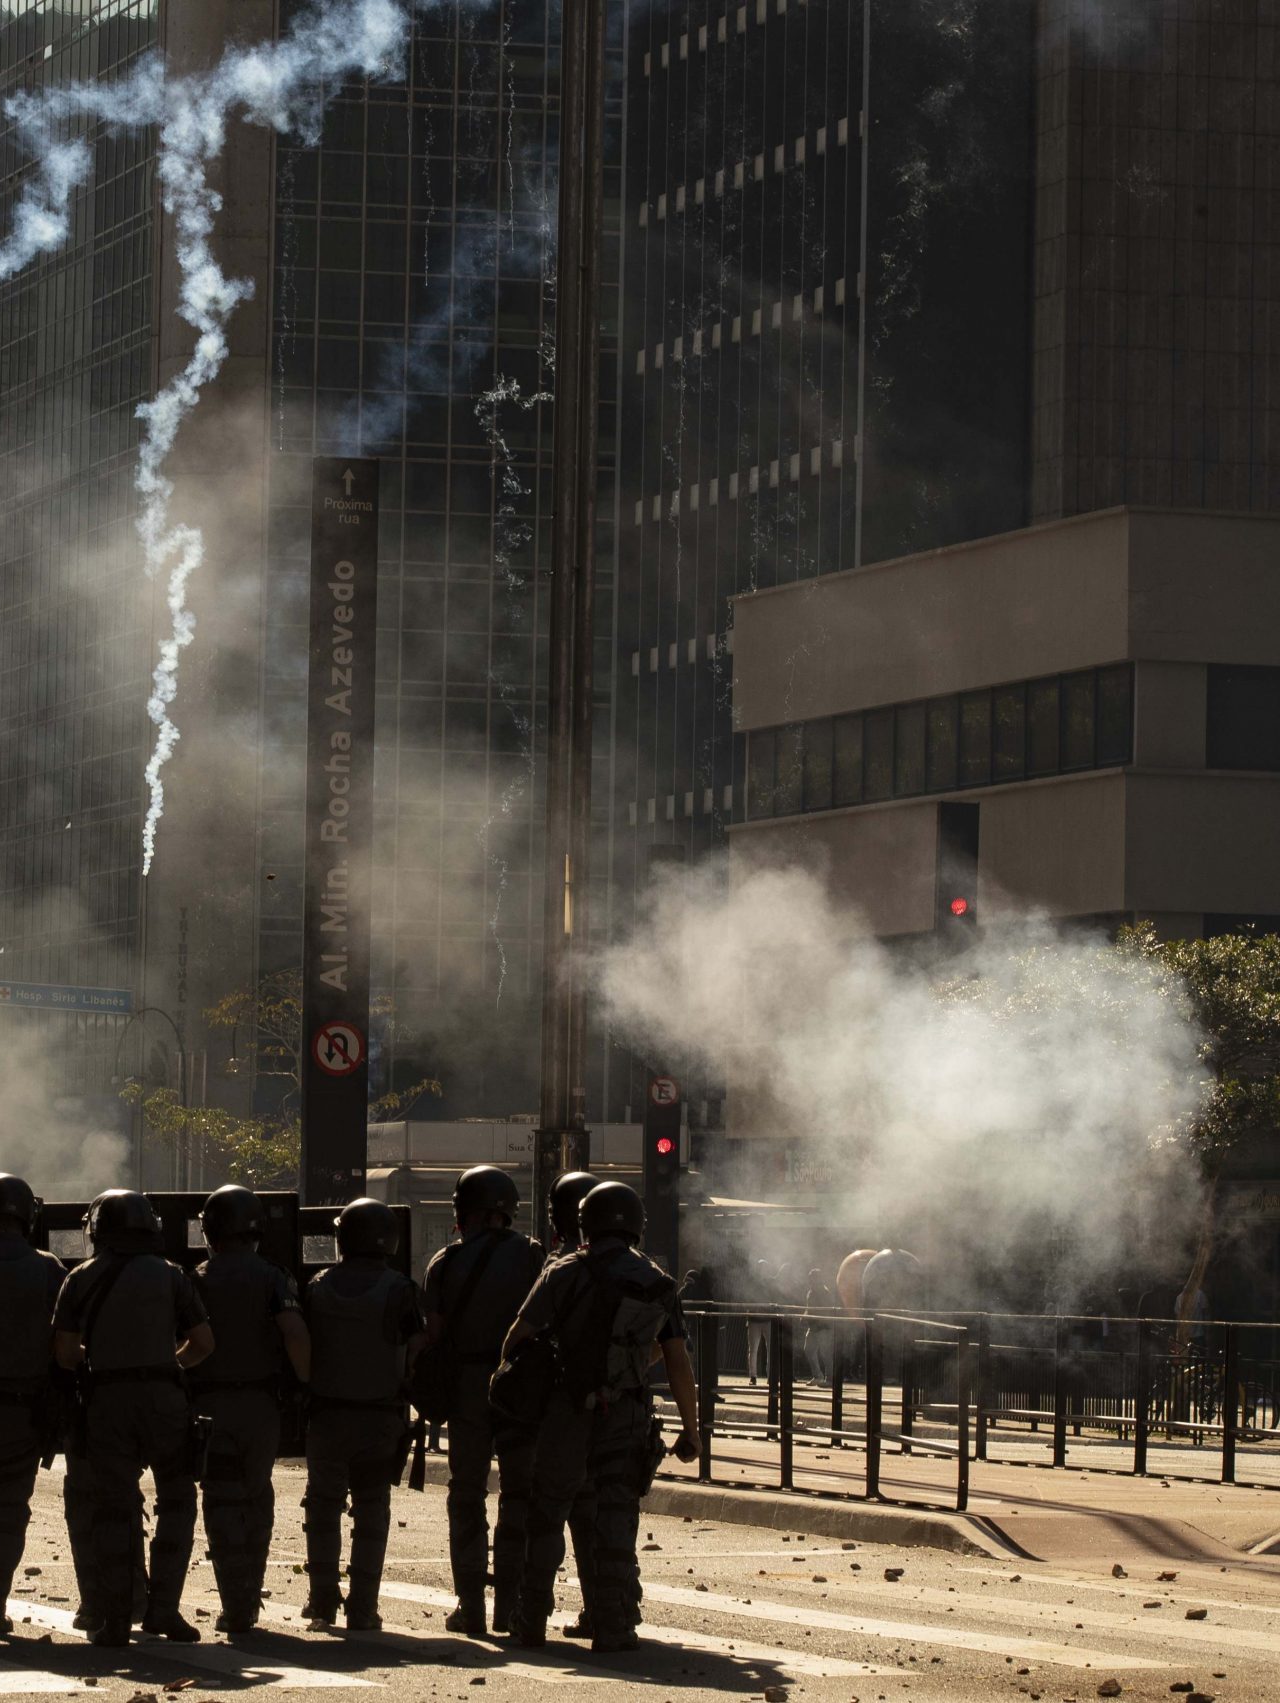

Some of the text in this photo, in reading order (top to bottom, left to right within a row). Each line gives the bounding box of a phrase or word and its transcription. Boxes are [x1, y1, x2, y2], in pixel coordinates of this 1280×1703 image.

[324, 497, 373, 512] Próxima
[338, 513, 360, 524] rua
[319, 560, 355, 992] Al. Min. Rocha Azevedo
[16, 989, 44, 1002] Hosp.
